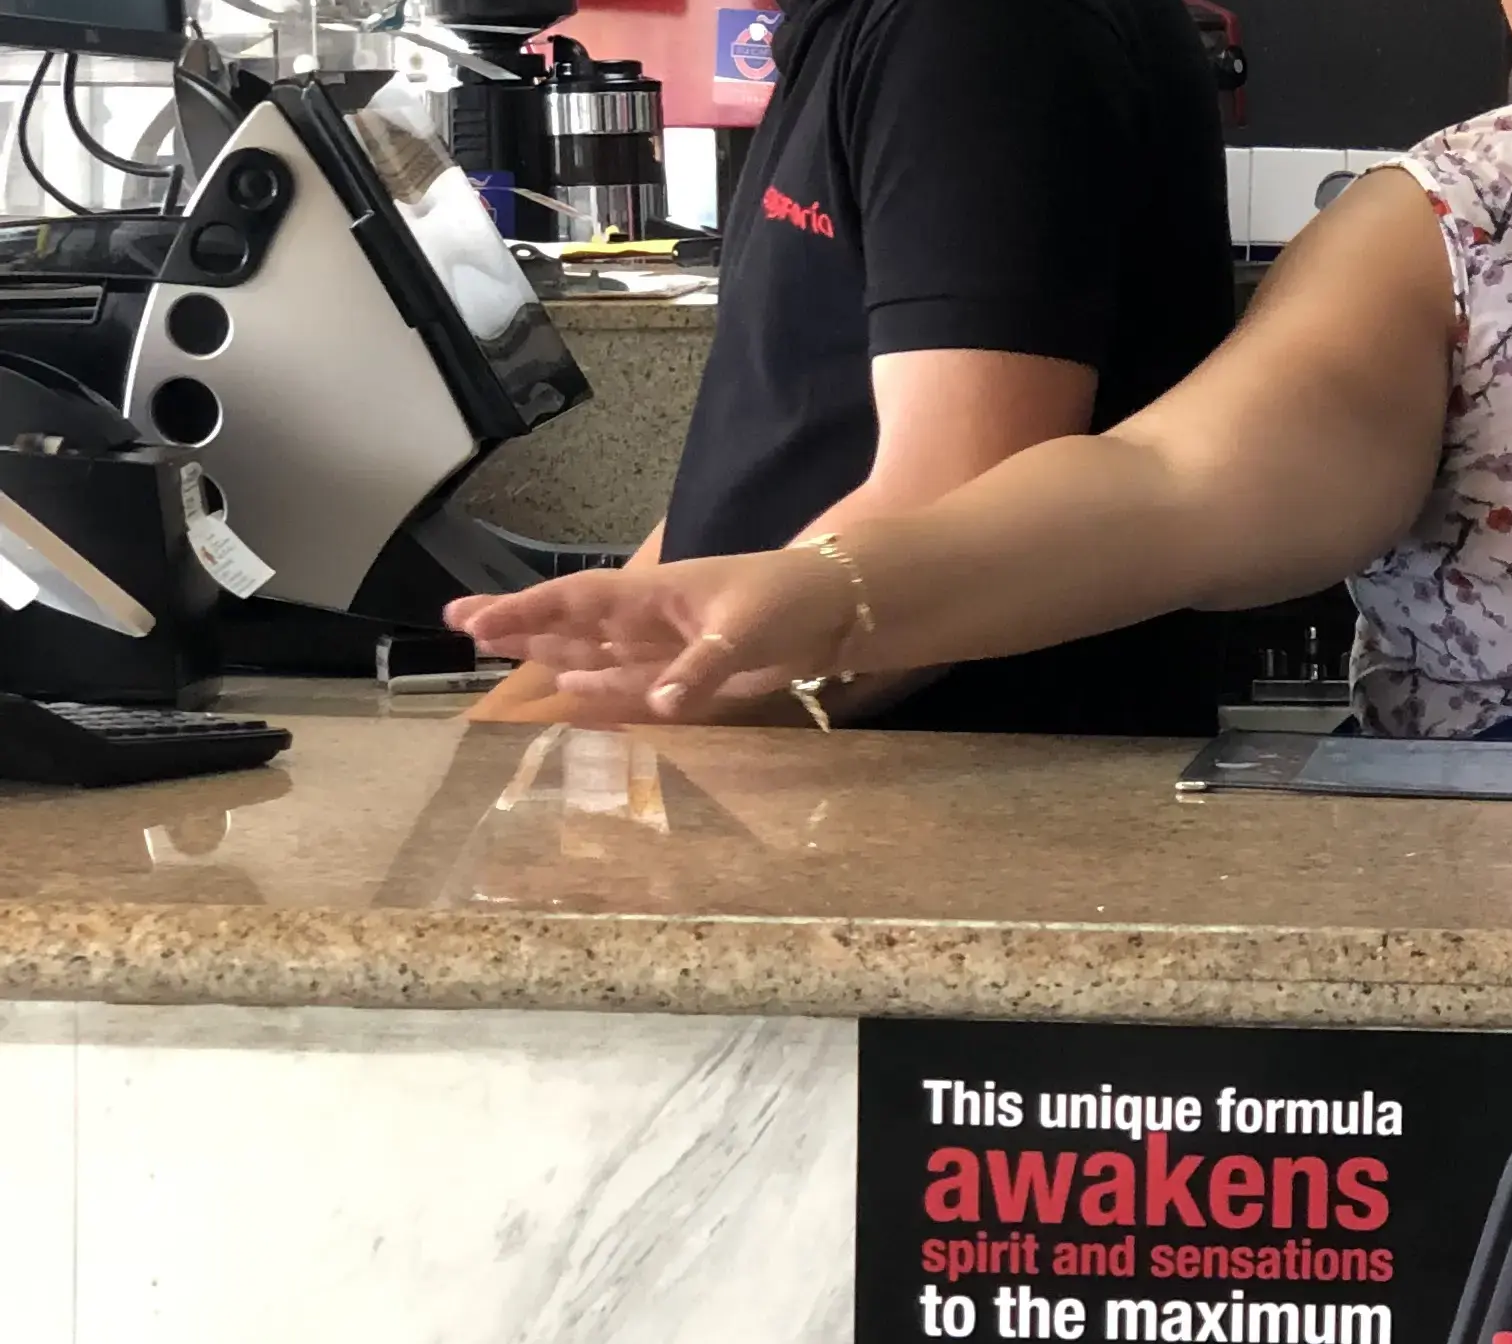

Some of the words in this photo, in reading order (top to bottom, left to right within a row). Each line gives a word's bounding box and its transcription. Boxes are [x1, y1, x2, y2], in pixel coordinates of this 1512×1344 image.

[922, 1080, 1024, 1128] This
[1039, 1084, 1202, 1141] unique
[1217, 1087, 1403, 1136] formula
[923, 1132, 1390, 1232] awakens
[922, 1231, 1040, 1282] spirit
[1052, 1236, 1136, 1278] and
[1150, 1239, 1394, 1283] sensations
[920, 1285, 976, 1338] to
[993, 1285, 1086, 1340] the
